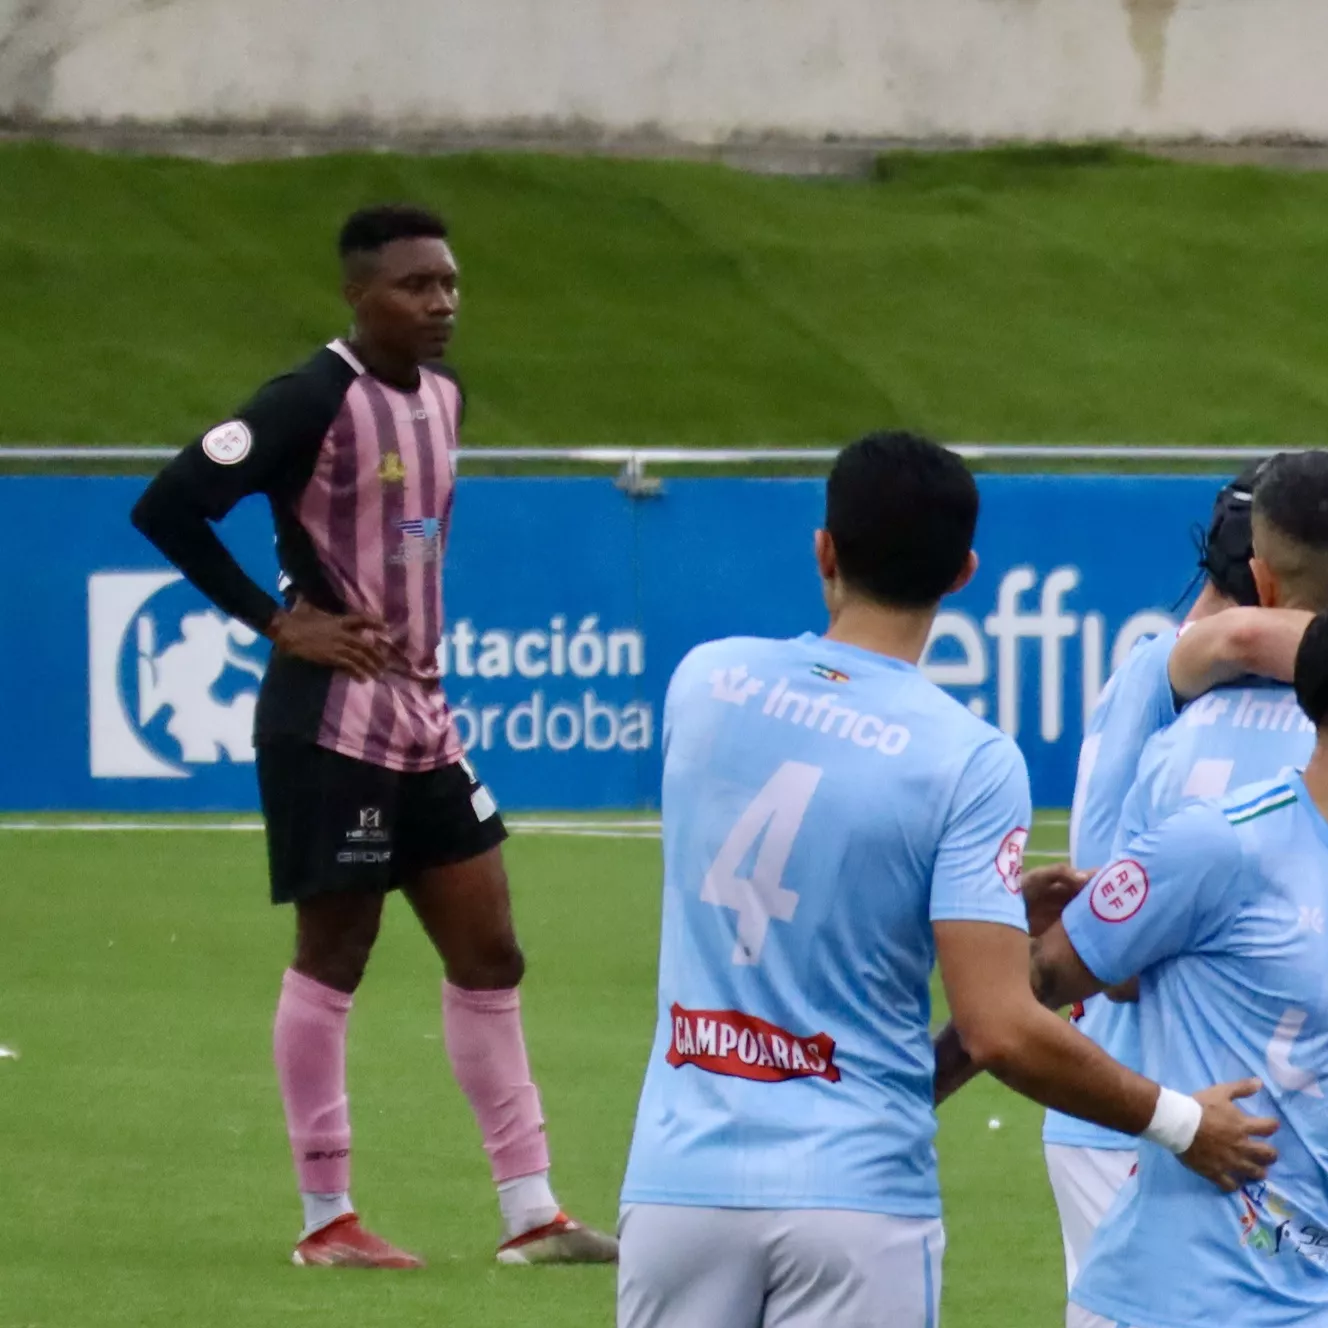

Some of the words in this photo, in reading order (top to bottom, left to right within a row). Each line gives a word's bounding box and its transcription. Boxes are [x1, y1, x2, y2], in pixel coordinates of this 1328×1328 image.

[763, 677, 911, 756] Infrico
[700, 760, 823, 966] 4
[674, 1016, 828, 1074] CAMPOARAS
